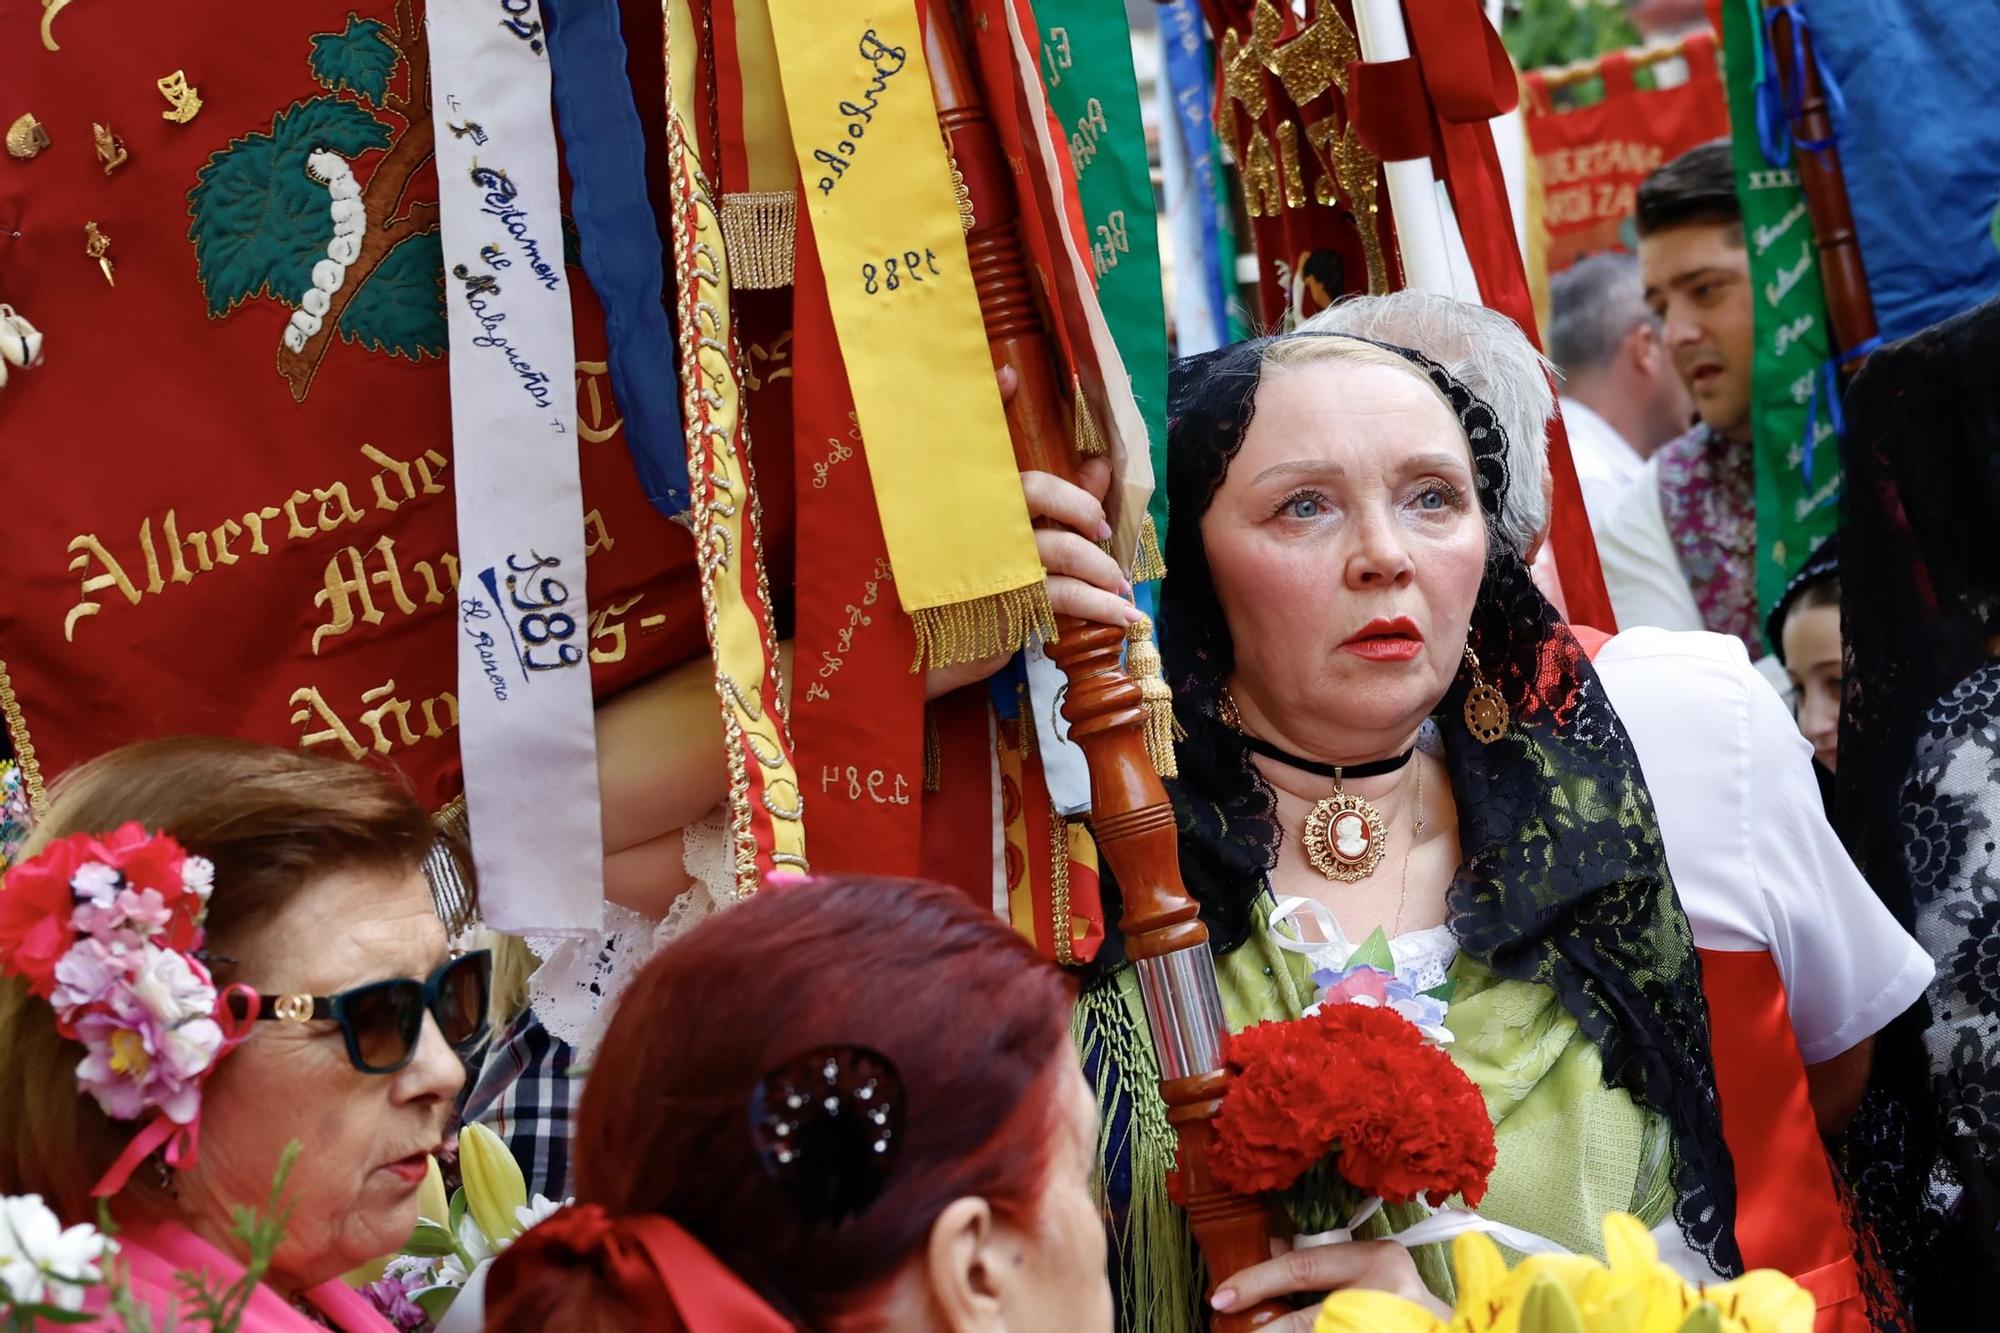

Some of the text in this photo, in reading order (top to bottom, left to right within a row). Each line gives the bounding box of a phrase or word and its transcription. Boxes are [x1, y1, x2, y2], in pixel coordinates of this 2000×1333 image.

[480, 243, 512, 271] de
[64, 443, 448, 643] Alberca de
[506, 548, 583, 671] 1989
